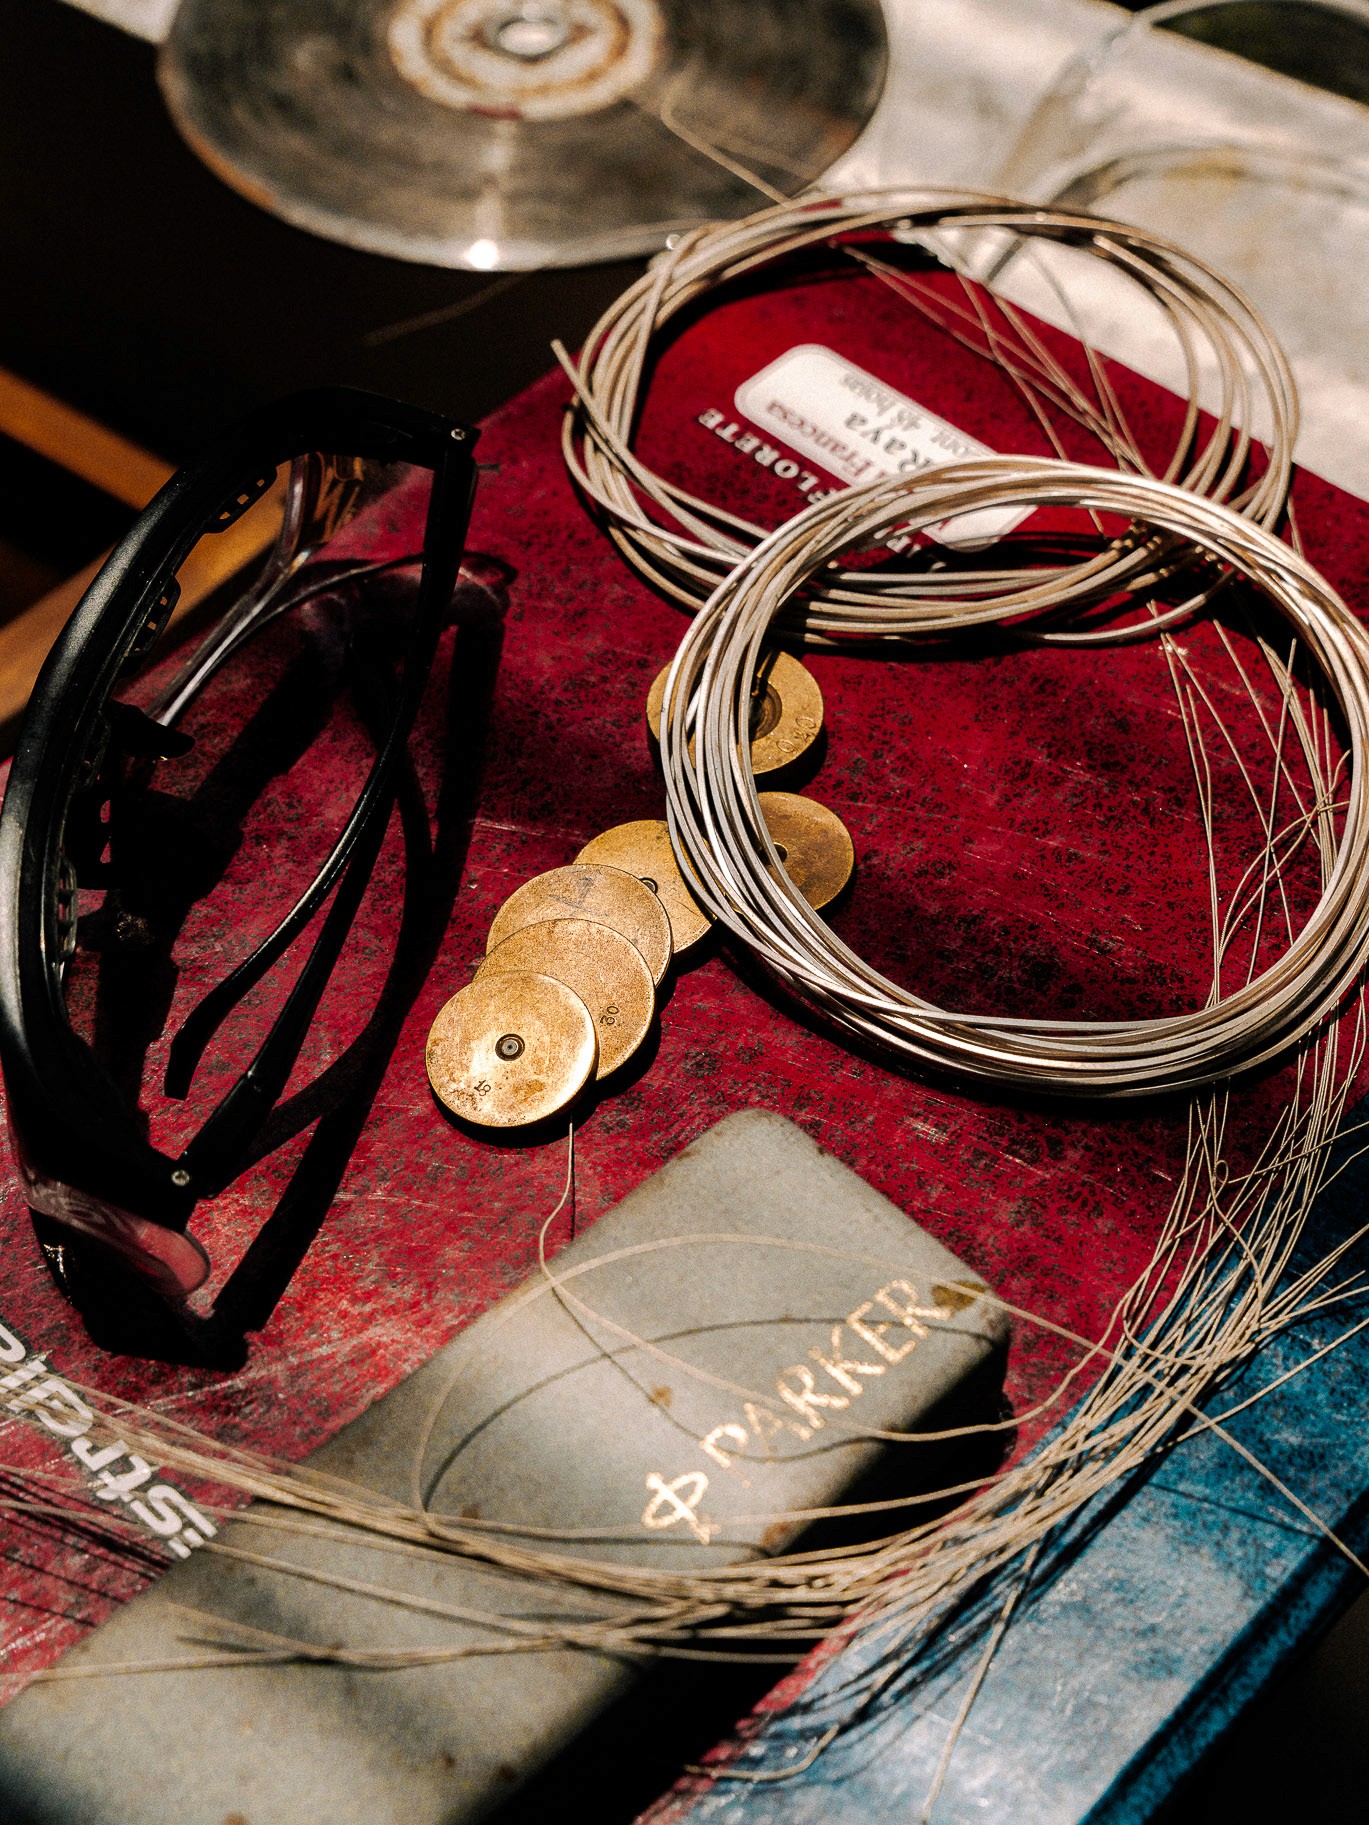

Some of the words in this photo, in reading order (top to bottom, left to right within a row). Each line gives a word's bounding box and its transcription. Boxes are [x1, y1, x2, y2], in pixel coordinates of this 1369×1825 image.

[767, 400, 874, 475] Francesa
[844, 412, 932, 473] Raya
[473, 1079, 492, 1097] 18
[700, 1279, 950, 1488] PARKER
